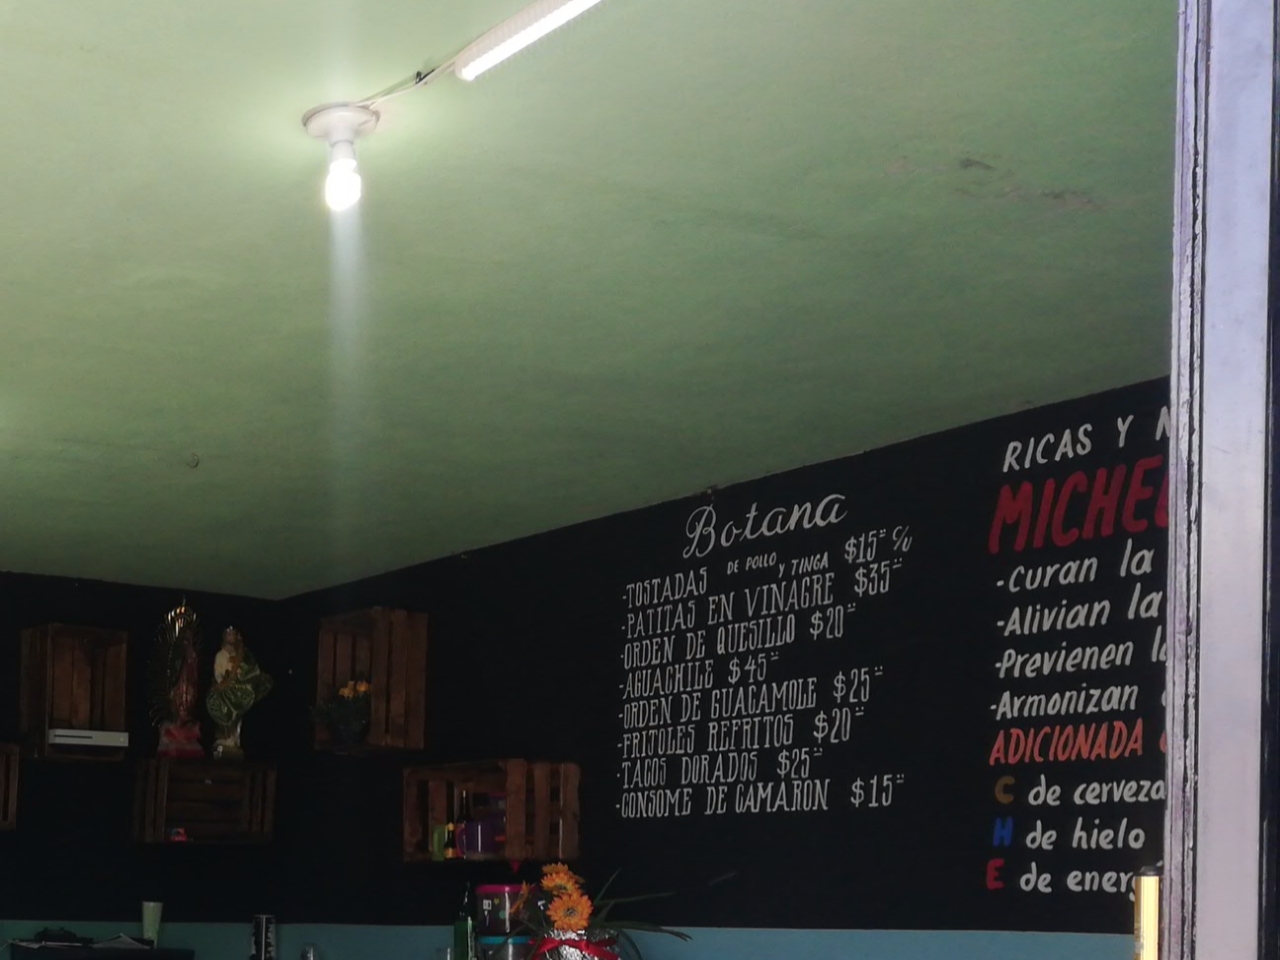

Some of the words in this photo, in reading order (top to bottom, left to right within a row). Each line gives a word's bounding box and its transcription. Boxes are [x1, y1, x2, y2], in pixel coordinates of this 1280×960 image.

[1003, 423, 1092, 473] RICAS
[1117, 414, 1134, 448] Y
[683, 494, 848, 559] Botana
[727, 561, 739, 575] DE
[746, 552, 777, 570] POLLO
[791, 551, 829, 576] TINGA
[1120, 538, 1155, 577] la
[708, 592, 734, 625] EN
[744, 572, 835, 618] VINAGRE
[1128, 582, 1163, 620] la
[686, 630, 706, 660] DE
[717, 613, 796, 655] QUESILLO
[680, 692, 701, 722] DE
[711, 677, 818, 719] GUACAMOLE
[707, 713, 794, 752] REFRITOS
[989, 717, 1143, 766] ADICIONADA
[681, 751, 758, 785] DORADOS
[704, 785, 728, 815] DE
[735, 778, 830, 814] CAMARON
[994, 775, 1015, 804] C
[1028, 773, 1061, 806] de
[1073, 779, 1166, 805] cerveza
[992, 816, 1014, 847] H
[1026, 819, 1057, 850] de
[1072, 816, 1146, 849] hielo
[986, 858, 1005, 889] E
[1020, 861, 1052, 893] de
